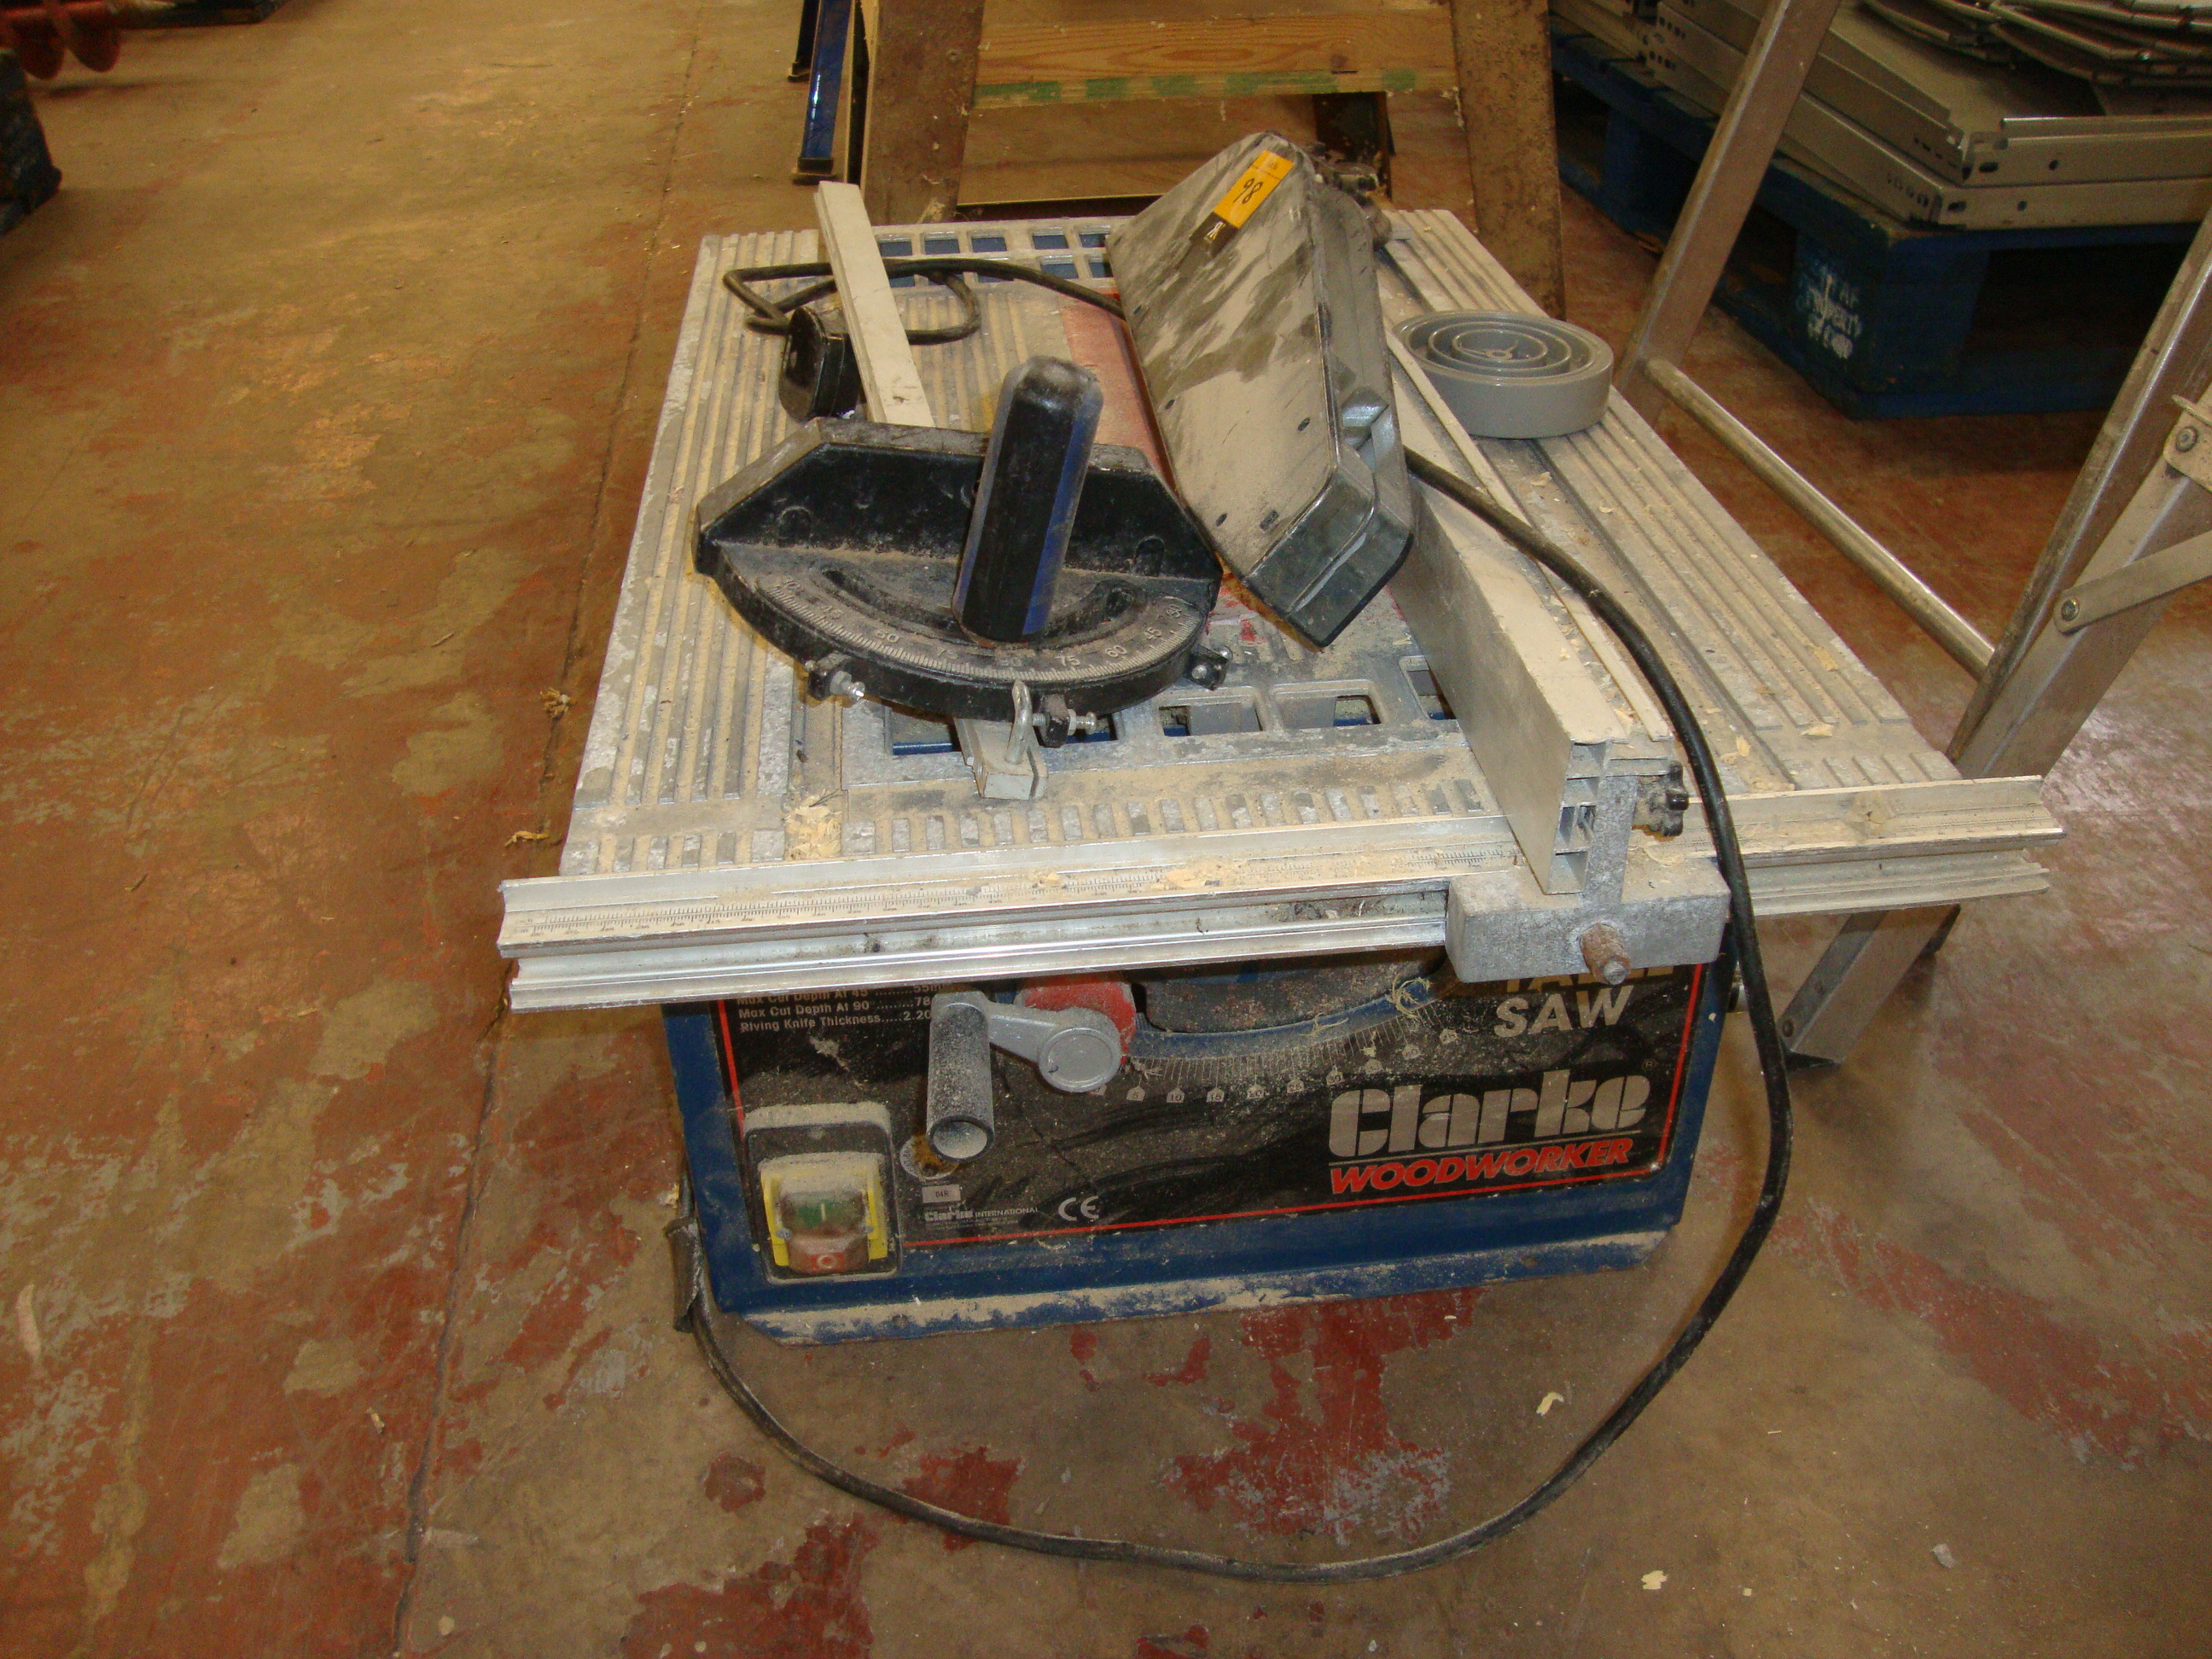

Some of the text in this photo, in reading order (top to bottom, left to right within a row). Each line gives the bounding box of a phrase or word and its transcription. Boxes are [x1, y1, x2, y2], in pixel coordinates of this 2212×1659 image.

[1232, 178, 1264, 205] 98
[1144, 626, 1162, 641] 45
[1105, 643, 1128, 659] 60
[1055, 653, 1080, 667] 75
[738, 1008, 766, 1018] Max
[770, 1005, 791, 1016] Cut
[795, 1003, 832, 1016] Depth
[836, 1001, 849, 1012] At
[1493, 985, 1635, 1038] SAW
[740, 1020, 780, 1033] Riving
[783, 1017, 817, 1030] Knife
[1328, 1068, 1651, 1158] Clarke
[1330, 1137, 1634, 1195] WOODWORKER
[975, 1207, 1039, 1218] INTERNATIONAL
